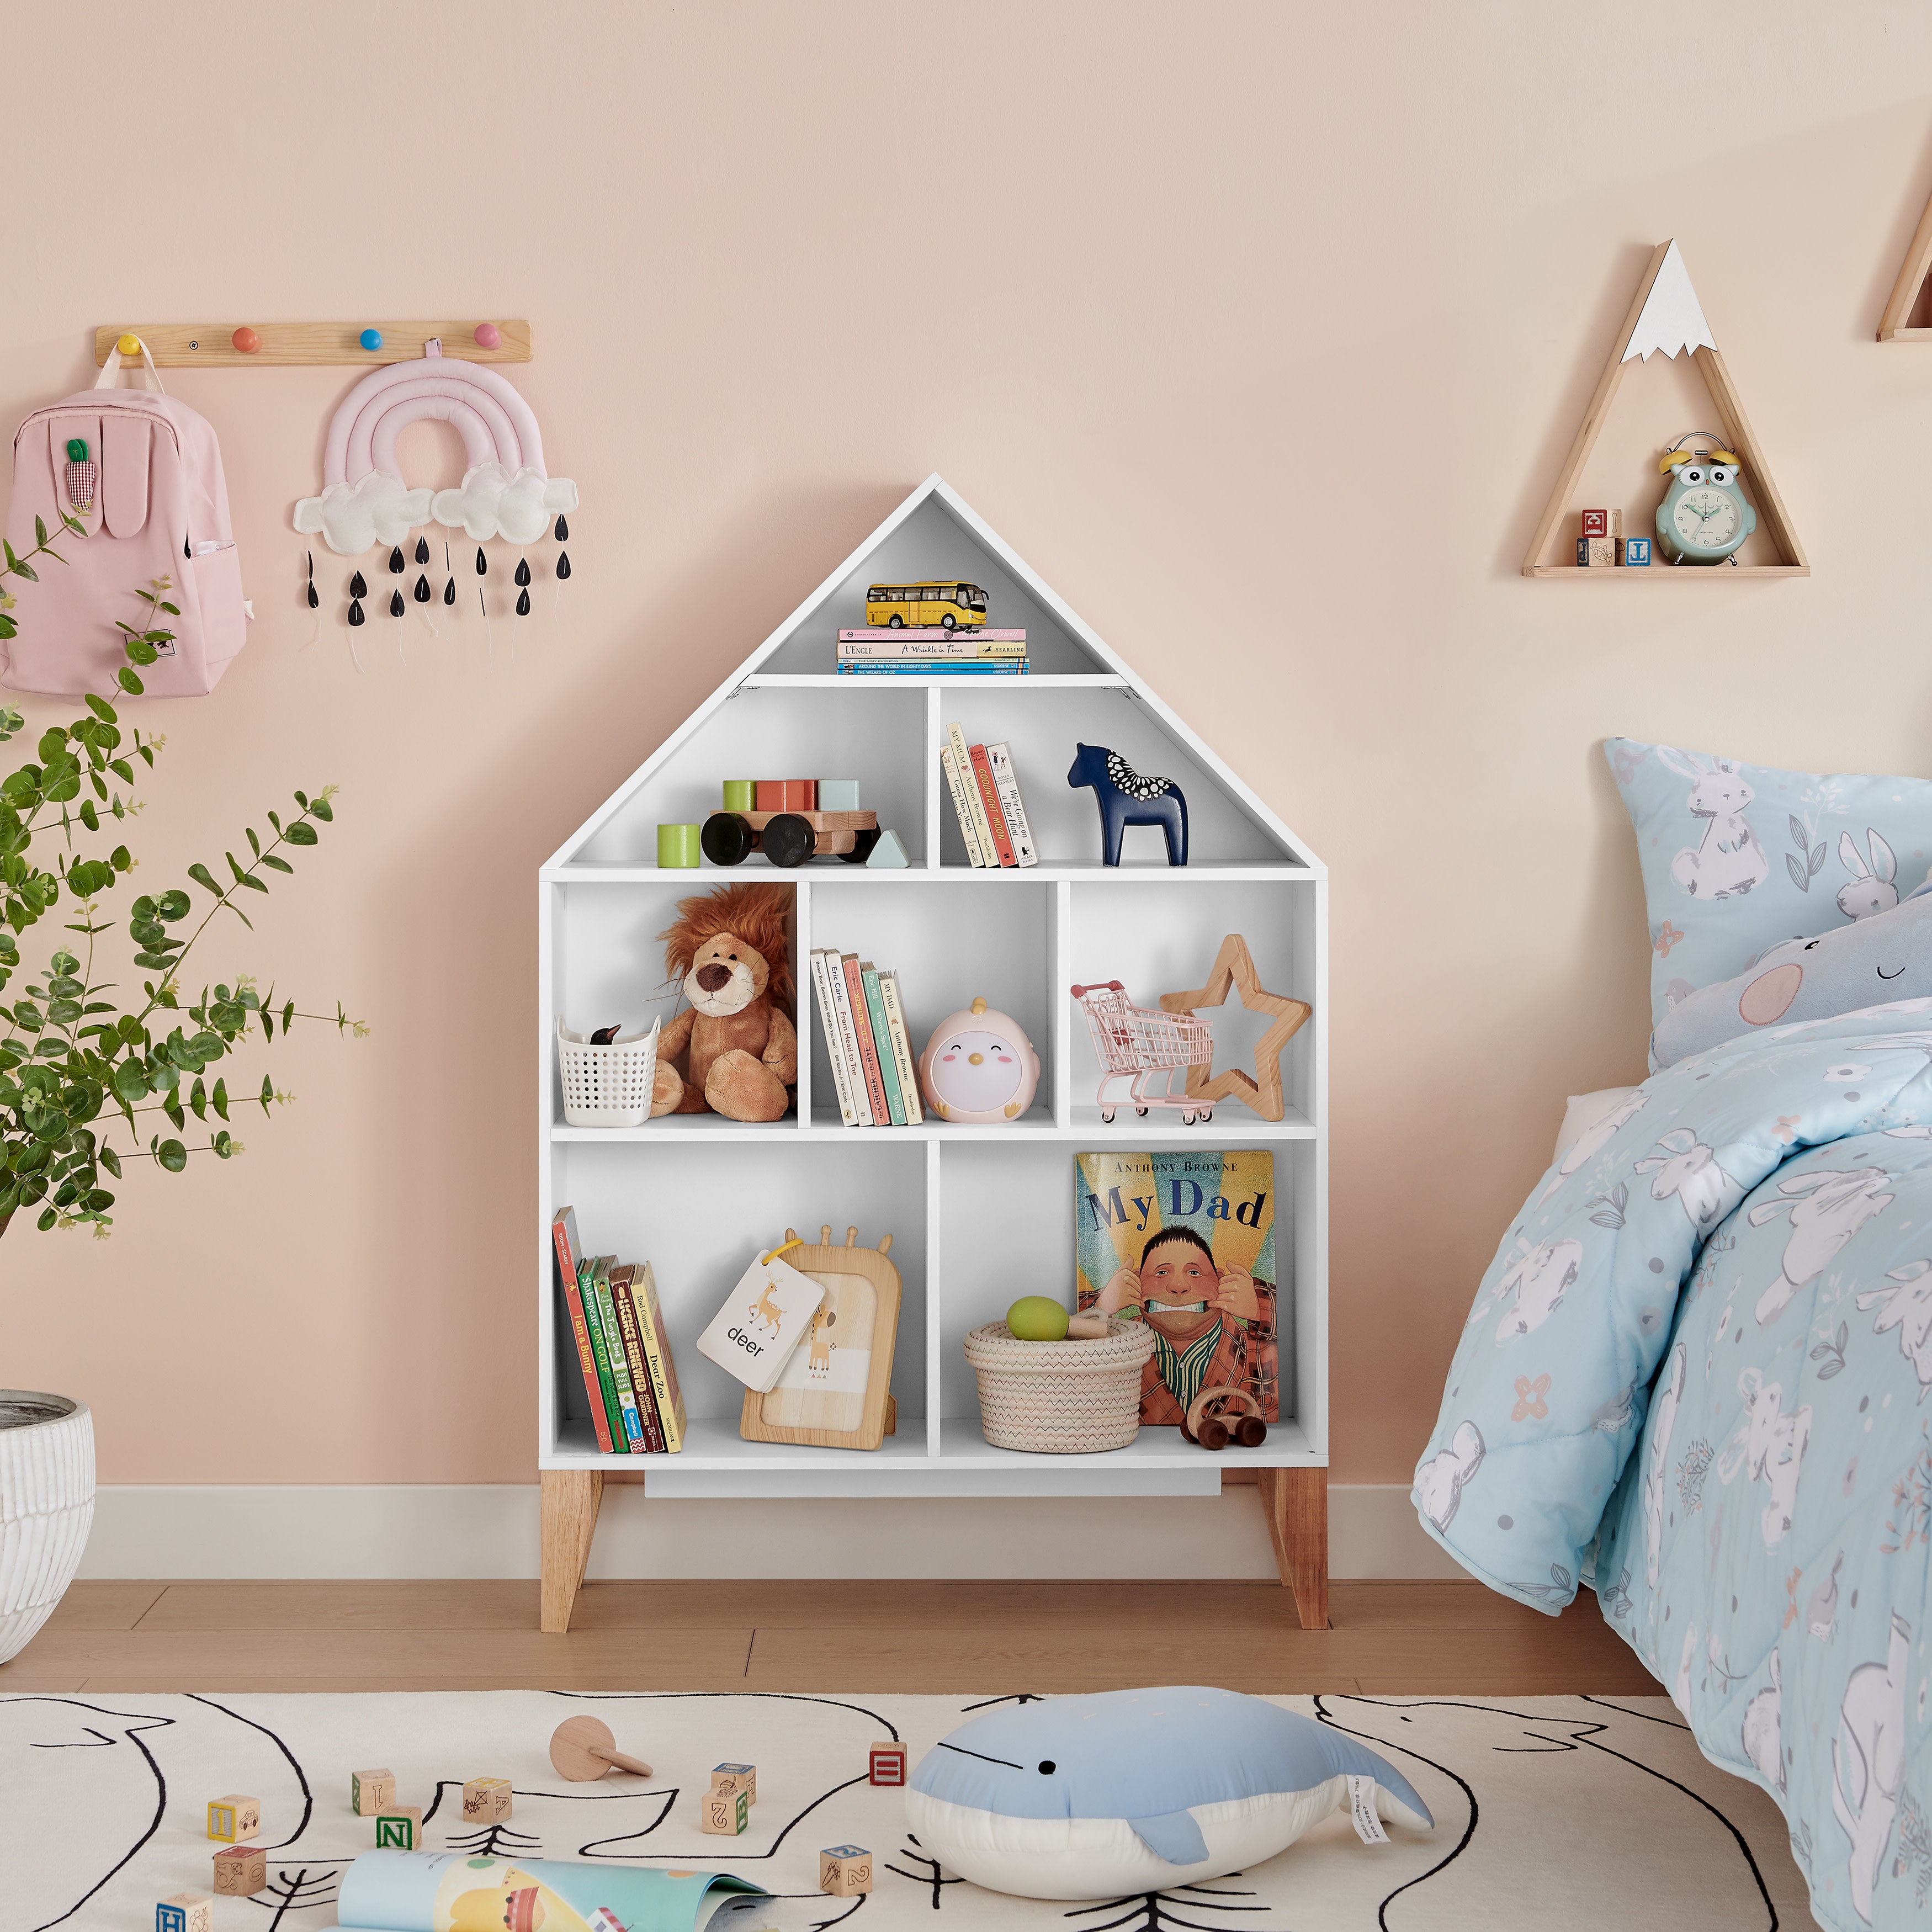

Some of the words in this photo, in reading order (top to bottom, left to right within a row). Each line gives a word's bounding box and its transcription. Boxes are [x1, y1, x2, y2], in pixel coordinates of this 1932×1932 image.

[1631, 543, 1646, 561] T
[885, 629, 914, 640] Animal
[915, 629, 938, 640] Farm
[990, 629, 1018, 639] Orwell
[902, 644, 909, 655] A
[911, 645, 937, 654] Wrinkle
[946, 644, 964, 654] Time
[952, 730, 959, 741] MY
[956, 744, 965, 763] MUM
[965, 776, 976, 802] Anthony
[974, 803, 983, 826] Browne
[978, 768, 999, 814] GOODNIGHT
[992, 817, 1006, 840] MOON
[1010, 789, 1019, 807] We're
[1015, 808, 1025, 829] Going
[1021, 829, 1028, 838] on
[964, 815, 973, 832] Much
[1004, 802, 1012, 817] Bear
[1009, 819, 1019, 837] Hunt
[983, 838, 991, 860] Doubleday
[884, 983, 891, 992] MY
[854, 992, 864, 1026] SALINGER
[845, 1033, 853, 1052] Head
[864, 1047, 873, 1062] RYE
[894, 1031, 903, 1057] Anthony
[900, 1058, 909, 1081] Browne
[870, 1077, 882, 1111] CATCHER
[893, 1094, 902, 1118] WARNE
[1114, 1161, 1175, 1172] ANTHONY
[1183, 1160, 1238, 1172] BROWNE
[1085, 1186, 1155, 1232] My
[1167, 1179, 1267, 1230] Dad
[582, 1277, 598, 1327] Shakespeare
[593, 1328, 604, 1344] ON
[640, 1309, 654, 1341] Campbell
[575, 1320, 584, 1336] am
[580, 1345, 592, 1373] Bunny
[612, 1342, 621, 1358] Book
[618, 1298, 636, 1340] LICENCE
[627, 1341, 647, 1392] RENEWED
[726, 1327, 765, 1358] deer
[597, 1346, 609, 1372] GOLF
[650, 1355, 660, 1379] Dear
[656, 1381, 665, 1399] Zoo
[638, 1394, 650, 1426] GARDNER
[644, 1393, 652, 1413] JOHN
[629, 1412, 638, 1437] Campbell
[666, 1418, 675, 1439] MACMILLAN
[381, 1823, 406, 1847] N
